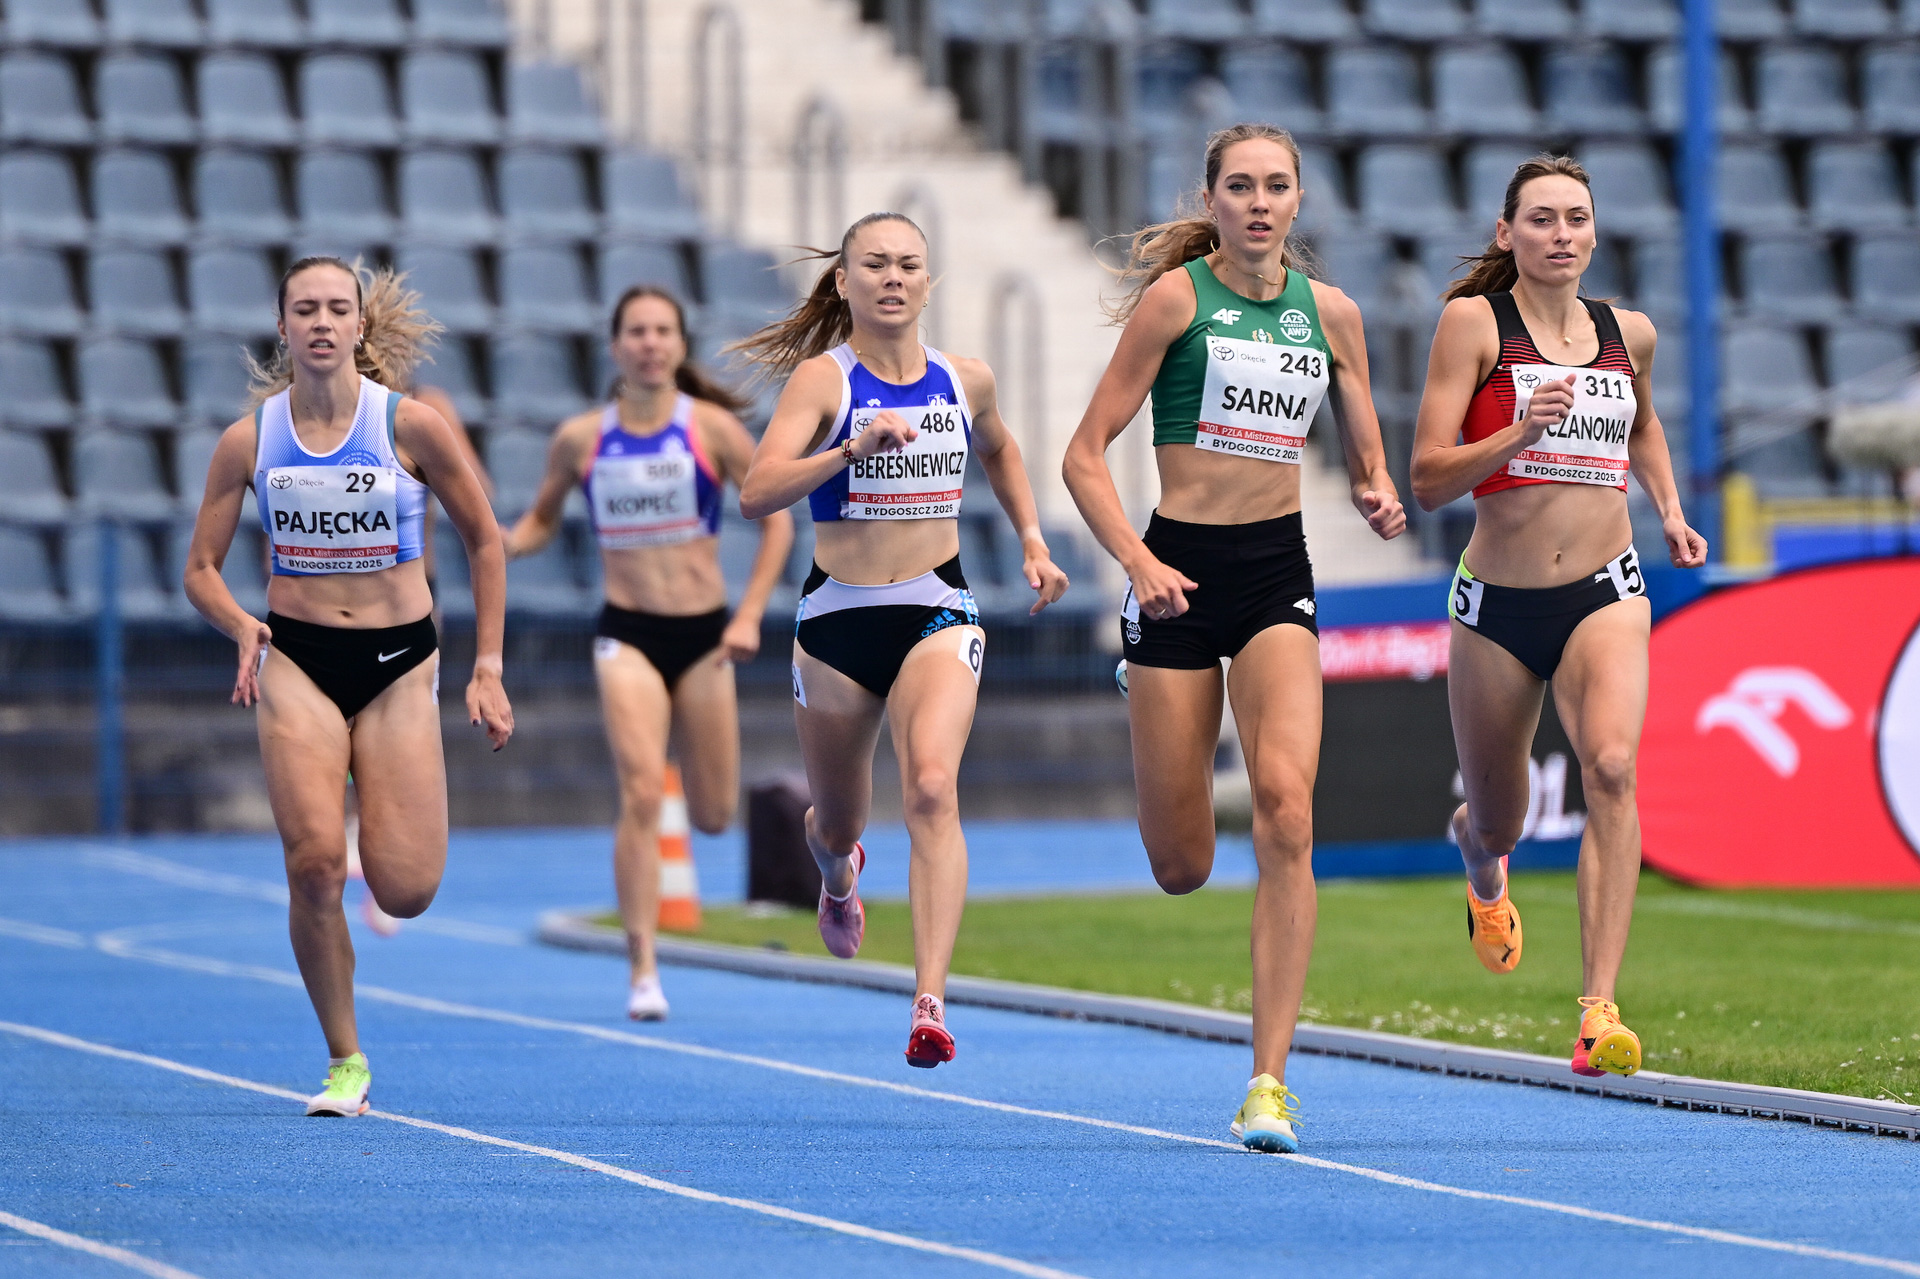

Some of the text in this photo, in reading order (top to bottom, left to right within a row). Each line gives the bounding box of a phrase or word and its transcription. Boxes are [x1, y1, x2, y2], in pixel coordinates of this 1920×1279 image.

[1211, 308, 1243, 326] 4F
[1285, 314, 1304, 324] AZS
[1287, 327, 1308, 337] AWF
[1240, 353, 1267, 364] Okęcie
[1279, 352, 1321, 379] 243
[1585, 375, 1626, 400] 311
[1221, 385, 1307, 421] SARNA
[920, 412, 955, 434] 486
[1205, 424, 1220, 434] 101.
[1222, 427, 1243, 438] PZLA
[1244, 431, 1294, 446] Mistrzostwa
[1212, 438, 1281, 458] BYDGOSZCZ
[854, 450, 965, 479] BEREŚNIEWICZ
[1533, 453, 1556, 463] PZLA
[1556, 455, 1603, 468] Mistrzostwa
[1604, 459, 1625, 469] Polski
[345, 472, 376, 493] 29
[1524, 465, 1617, 482] BYDGOSZCZ 2025
[298, 480, 325, 488] Okęcie
[856, 490, 959, 503] 101. PZLA Mistrzostwa Polski
[864, 504, 953, 516] BYDGOSZCZ 2025
[274, 510, 392, 539] PAJĘCKA
[279, 546, 392, 558] 101. PZLA Mistrzostwa Polski
[288, 559, 383, 570] BYDGOSZCZ 2025
[1619, 551, 1642, 594] 5
[1455, 576, 1473, 617] 5
[968, 637, 982, 673] 6
